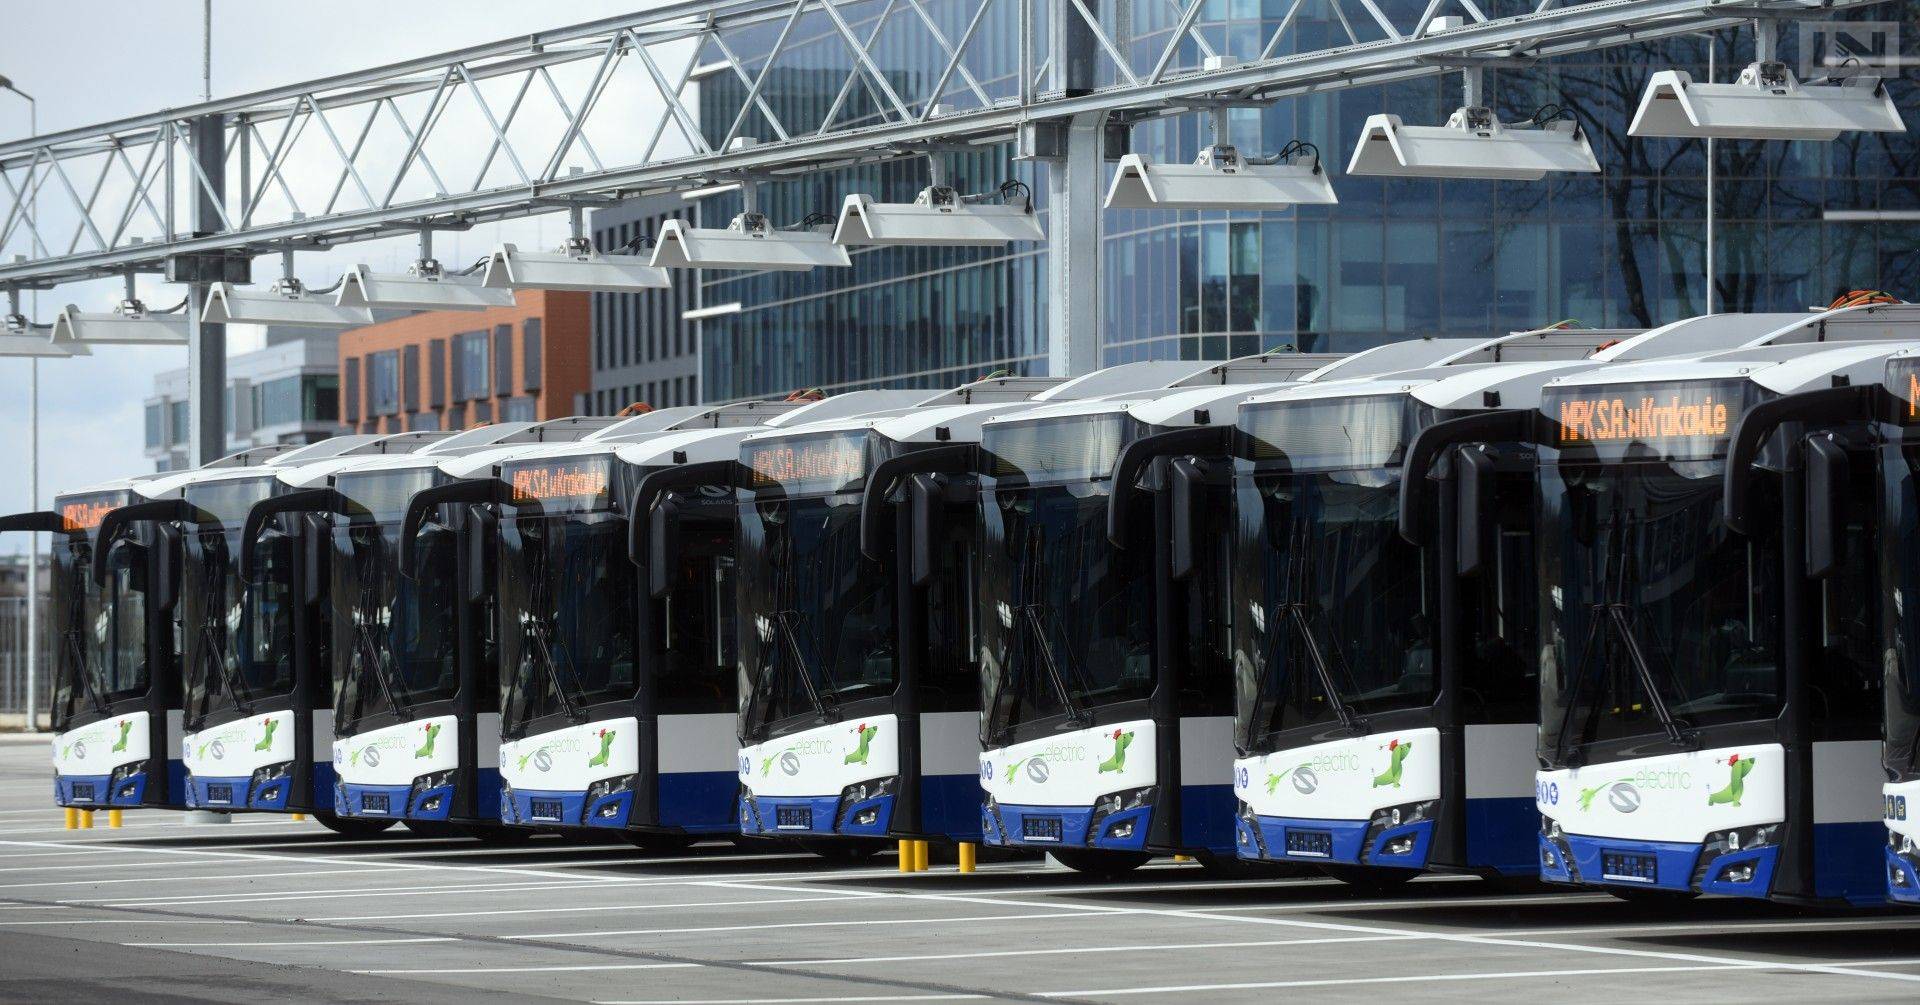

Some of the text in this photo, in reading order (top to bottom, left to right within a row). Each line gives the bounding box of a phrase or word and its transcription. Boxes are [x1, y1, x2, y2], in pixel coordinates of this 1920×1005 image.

[1561, 401, 1596, 440] MPK
[1641, 396, 1728, 437] Krakowie
[549, 735, 581, 754] electric
[796, 736, 832, 756] electric
[1045, 741, 1086, 762] electric
[1313, 750, 1360, 772] electric
[1635, 765, 1692, 790] electric
